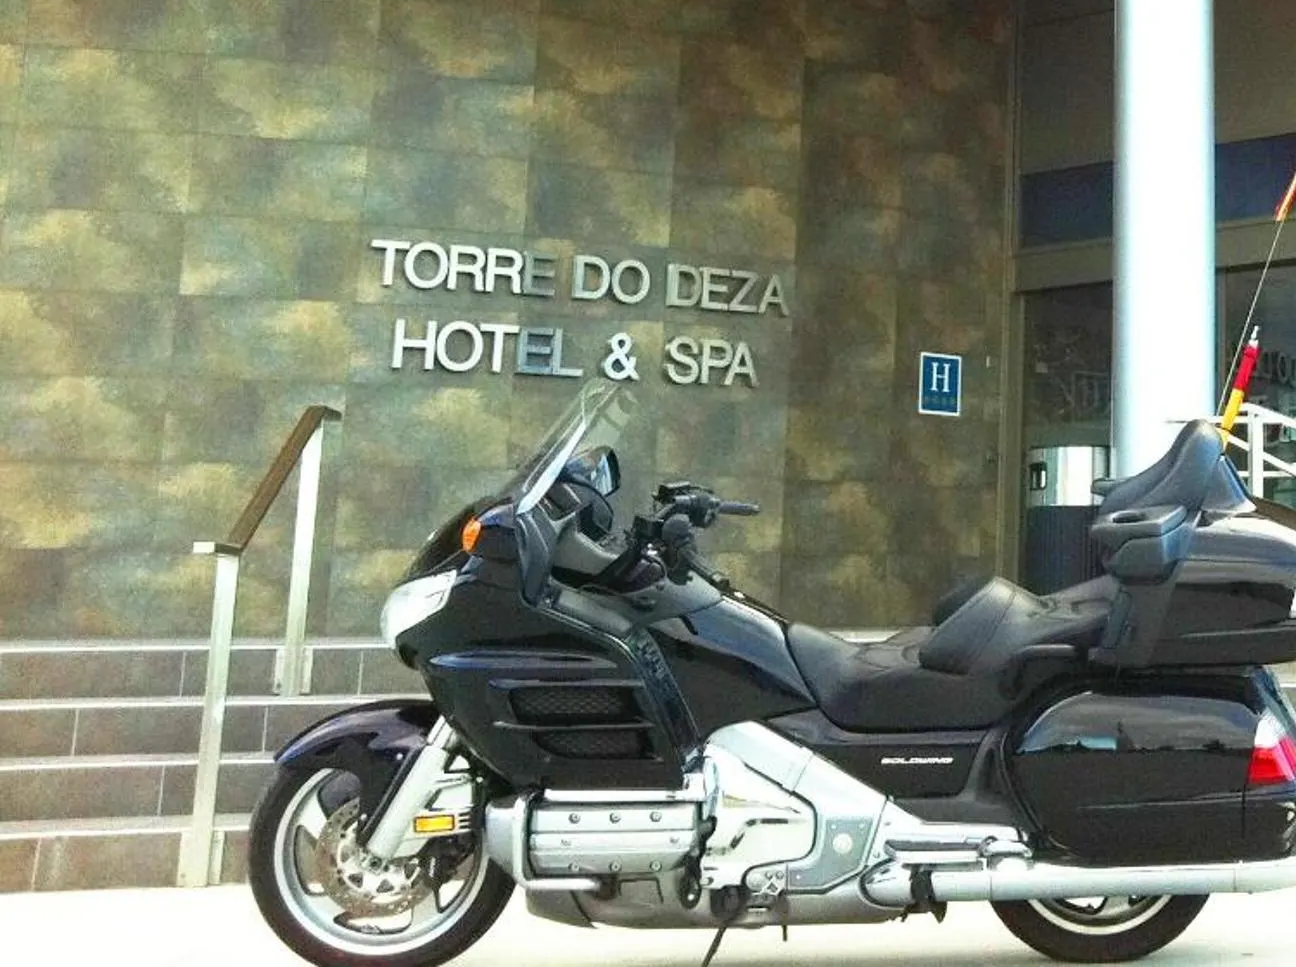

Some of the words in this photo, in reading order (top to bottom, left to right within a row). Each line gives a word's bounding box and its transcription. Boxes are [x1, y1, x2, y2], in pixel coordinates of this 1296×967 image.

[371, 239, 556, 296] TORRE
[571, 254, 651, 304] DO
[665, 263, 789, 315] DEZA
[391, 319, 584, 377] HOTEL
[603, 332, 639, 381] &
[663, 336, 759, 387] SPA
[930, 362, 951, 392] H
